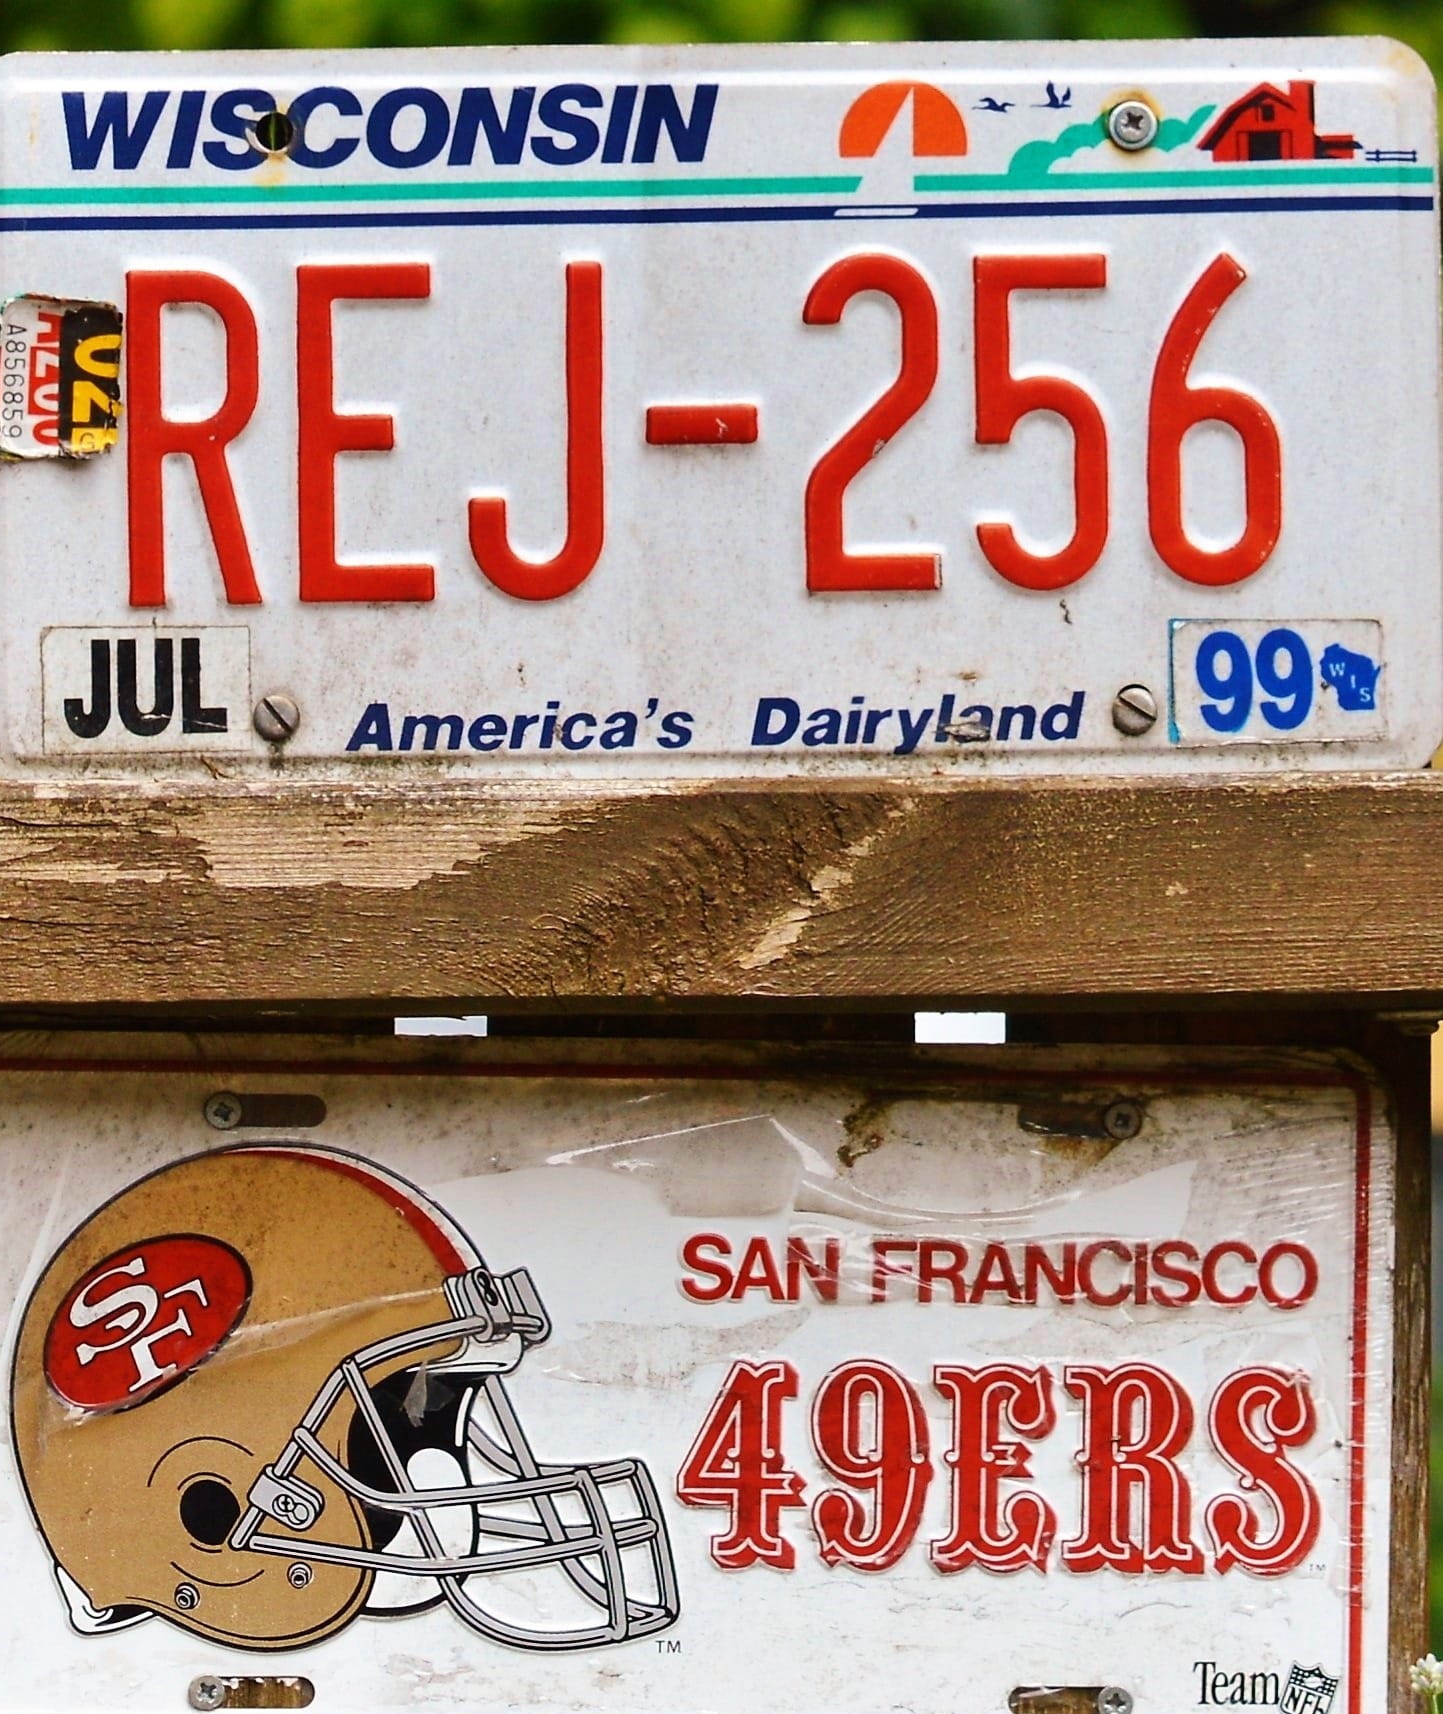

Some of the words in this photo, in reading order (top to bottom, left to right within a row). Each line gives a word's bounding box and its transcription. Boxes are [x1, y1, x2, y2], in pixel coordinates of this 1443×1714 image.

[62, 84, 719, 170] WISCONSIN
[2, 324, 27, 439] A856859
[125, 254, 1282, 612] REJ-256
[64, 638, 228, 738] JUL
[343, 698, 694, 752] America's
[750, 690, 1084, 749] Dairyland
[1196, 628, 1313, 733] 99
[682, 1233, 840, 1305] SAN
[868, 1237, 1318, 1312] FRANCISCO
[679, 1362, 1320, 1576] 49ERS
[656, 1640, 681, 1653] TM
[1194, 1662, 1279, 1705] Team
